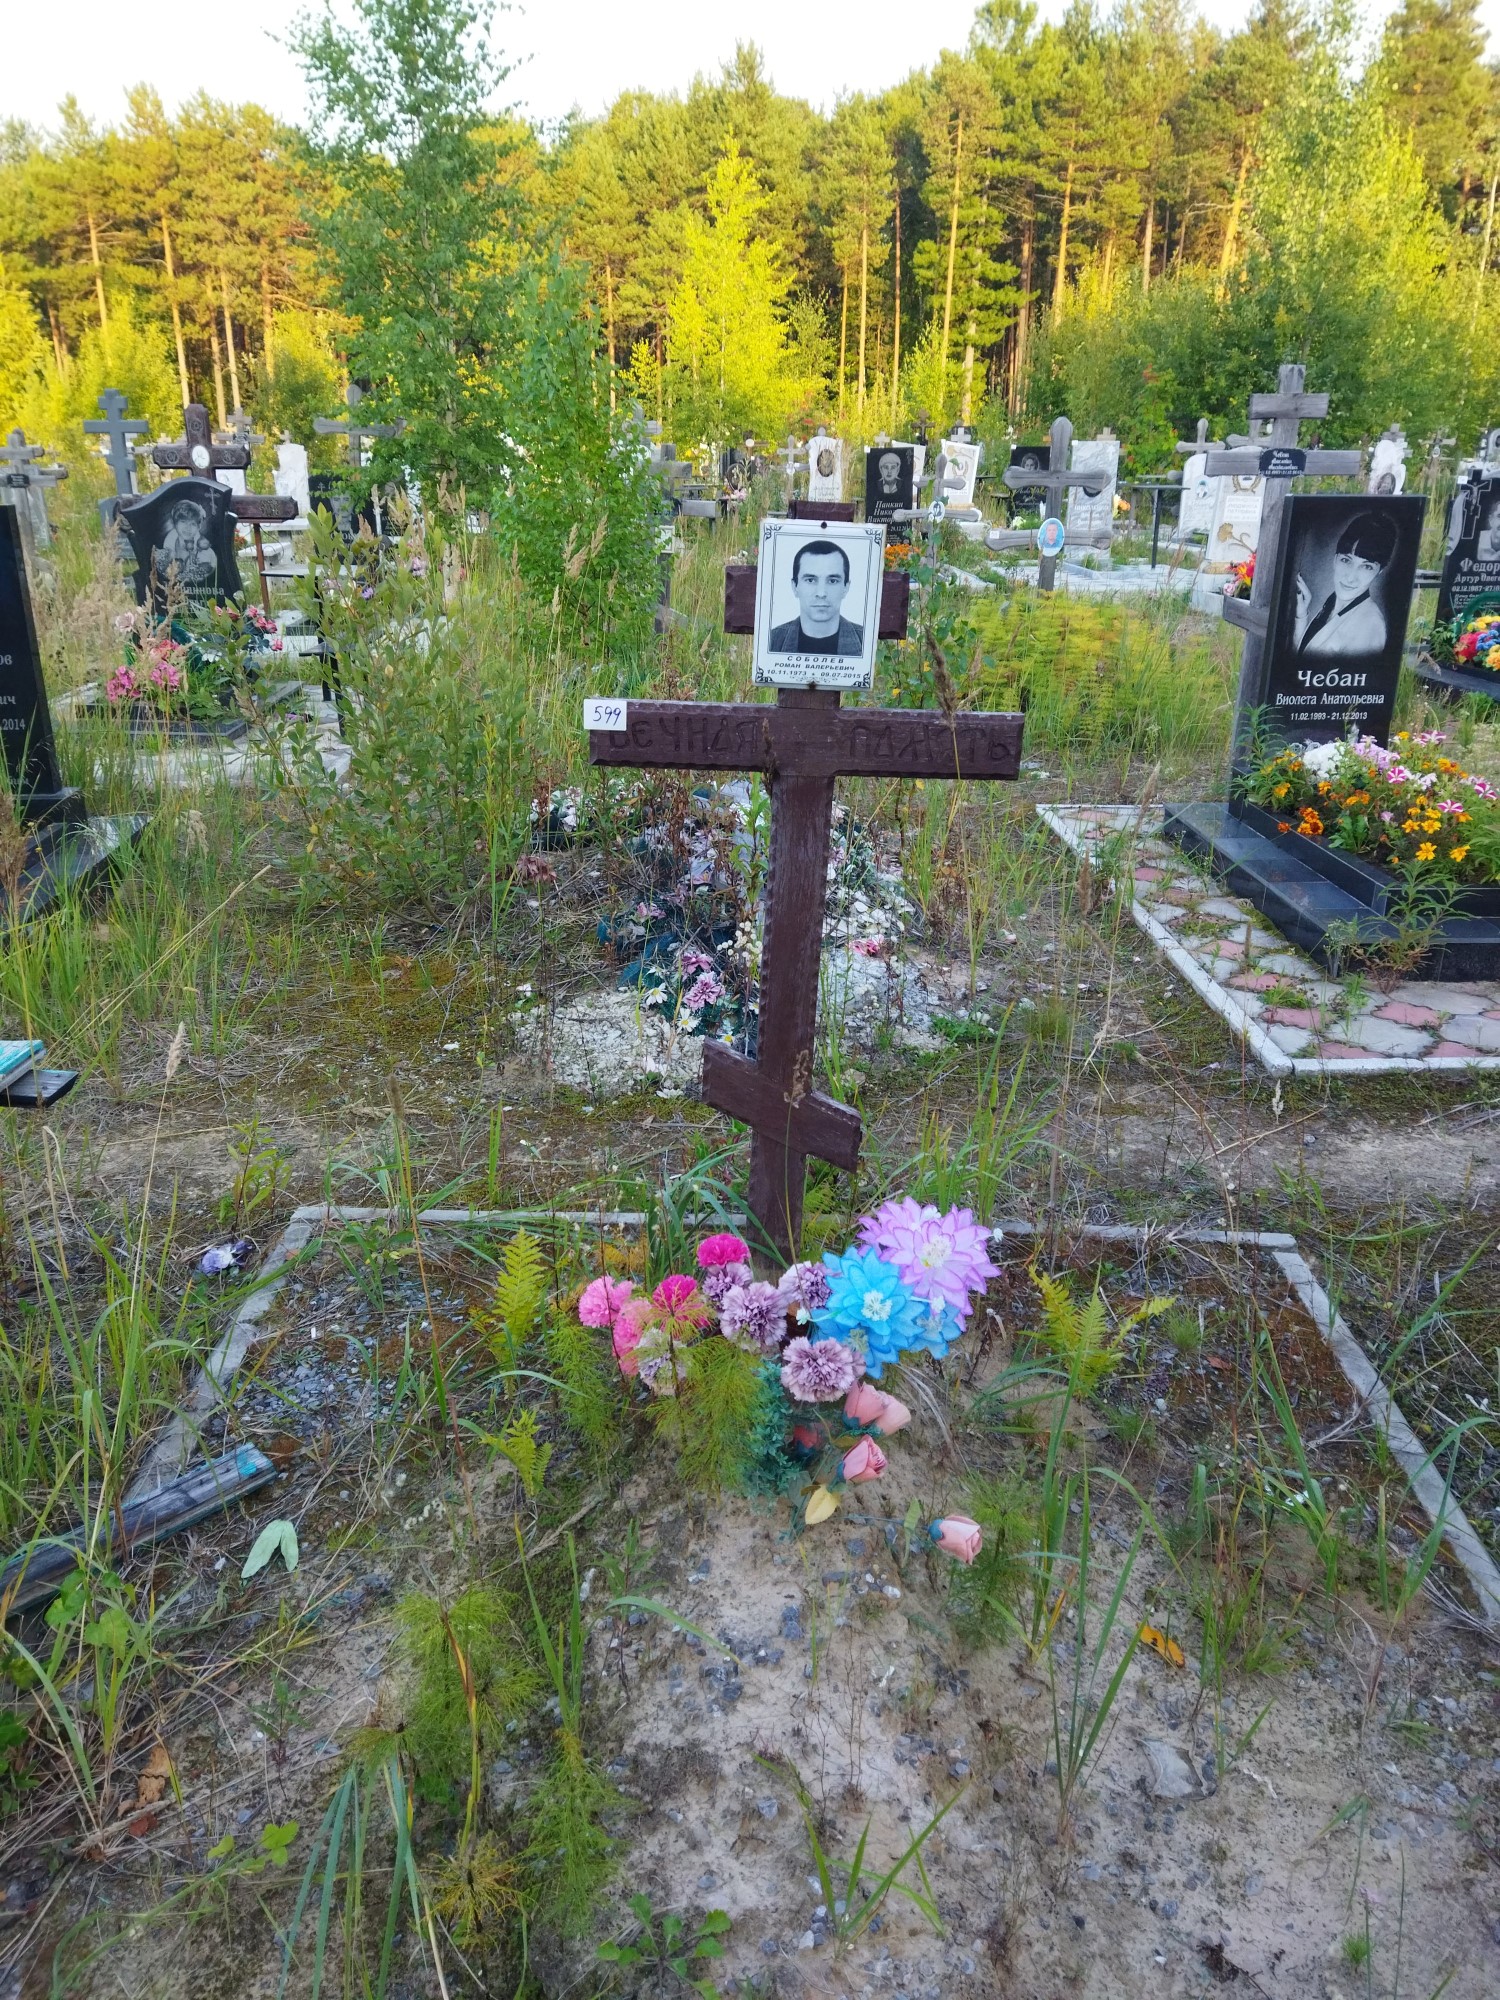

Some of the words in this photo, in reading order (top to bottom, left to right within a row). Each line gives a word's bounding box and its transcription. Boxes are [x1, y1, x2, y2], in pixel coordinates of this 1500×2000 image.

[1453, 573, 1480, 584] Артур
[787, 655, 844, 664] СОБОЛЕВ
[805, 663, 855, 671] ВАЛЕРЬЕВИЧ
[820, 671, 861, 679] 09.07.2015
[1297, 667, 1367, 687] Чебан
[1276, 693, 1317, 705] Виолета
[1320, 692, 1385, 704] Анатольевна
[592, 705, 622, 727] 599
[1290, 712, 1326, 721] 11.02.1993
[1331, 711, 1368, 720] 21.12.2013
